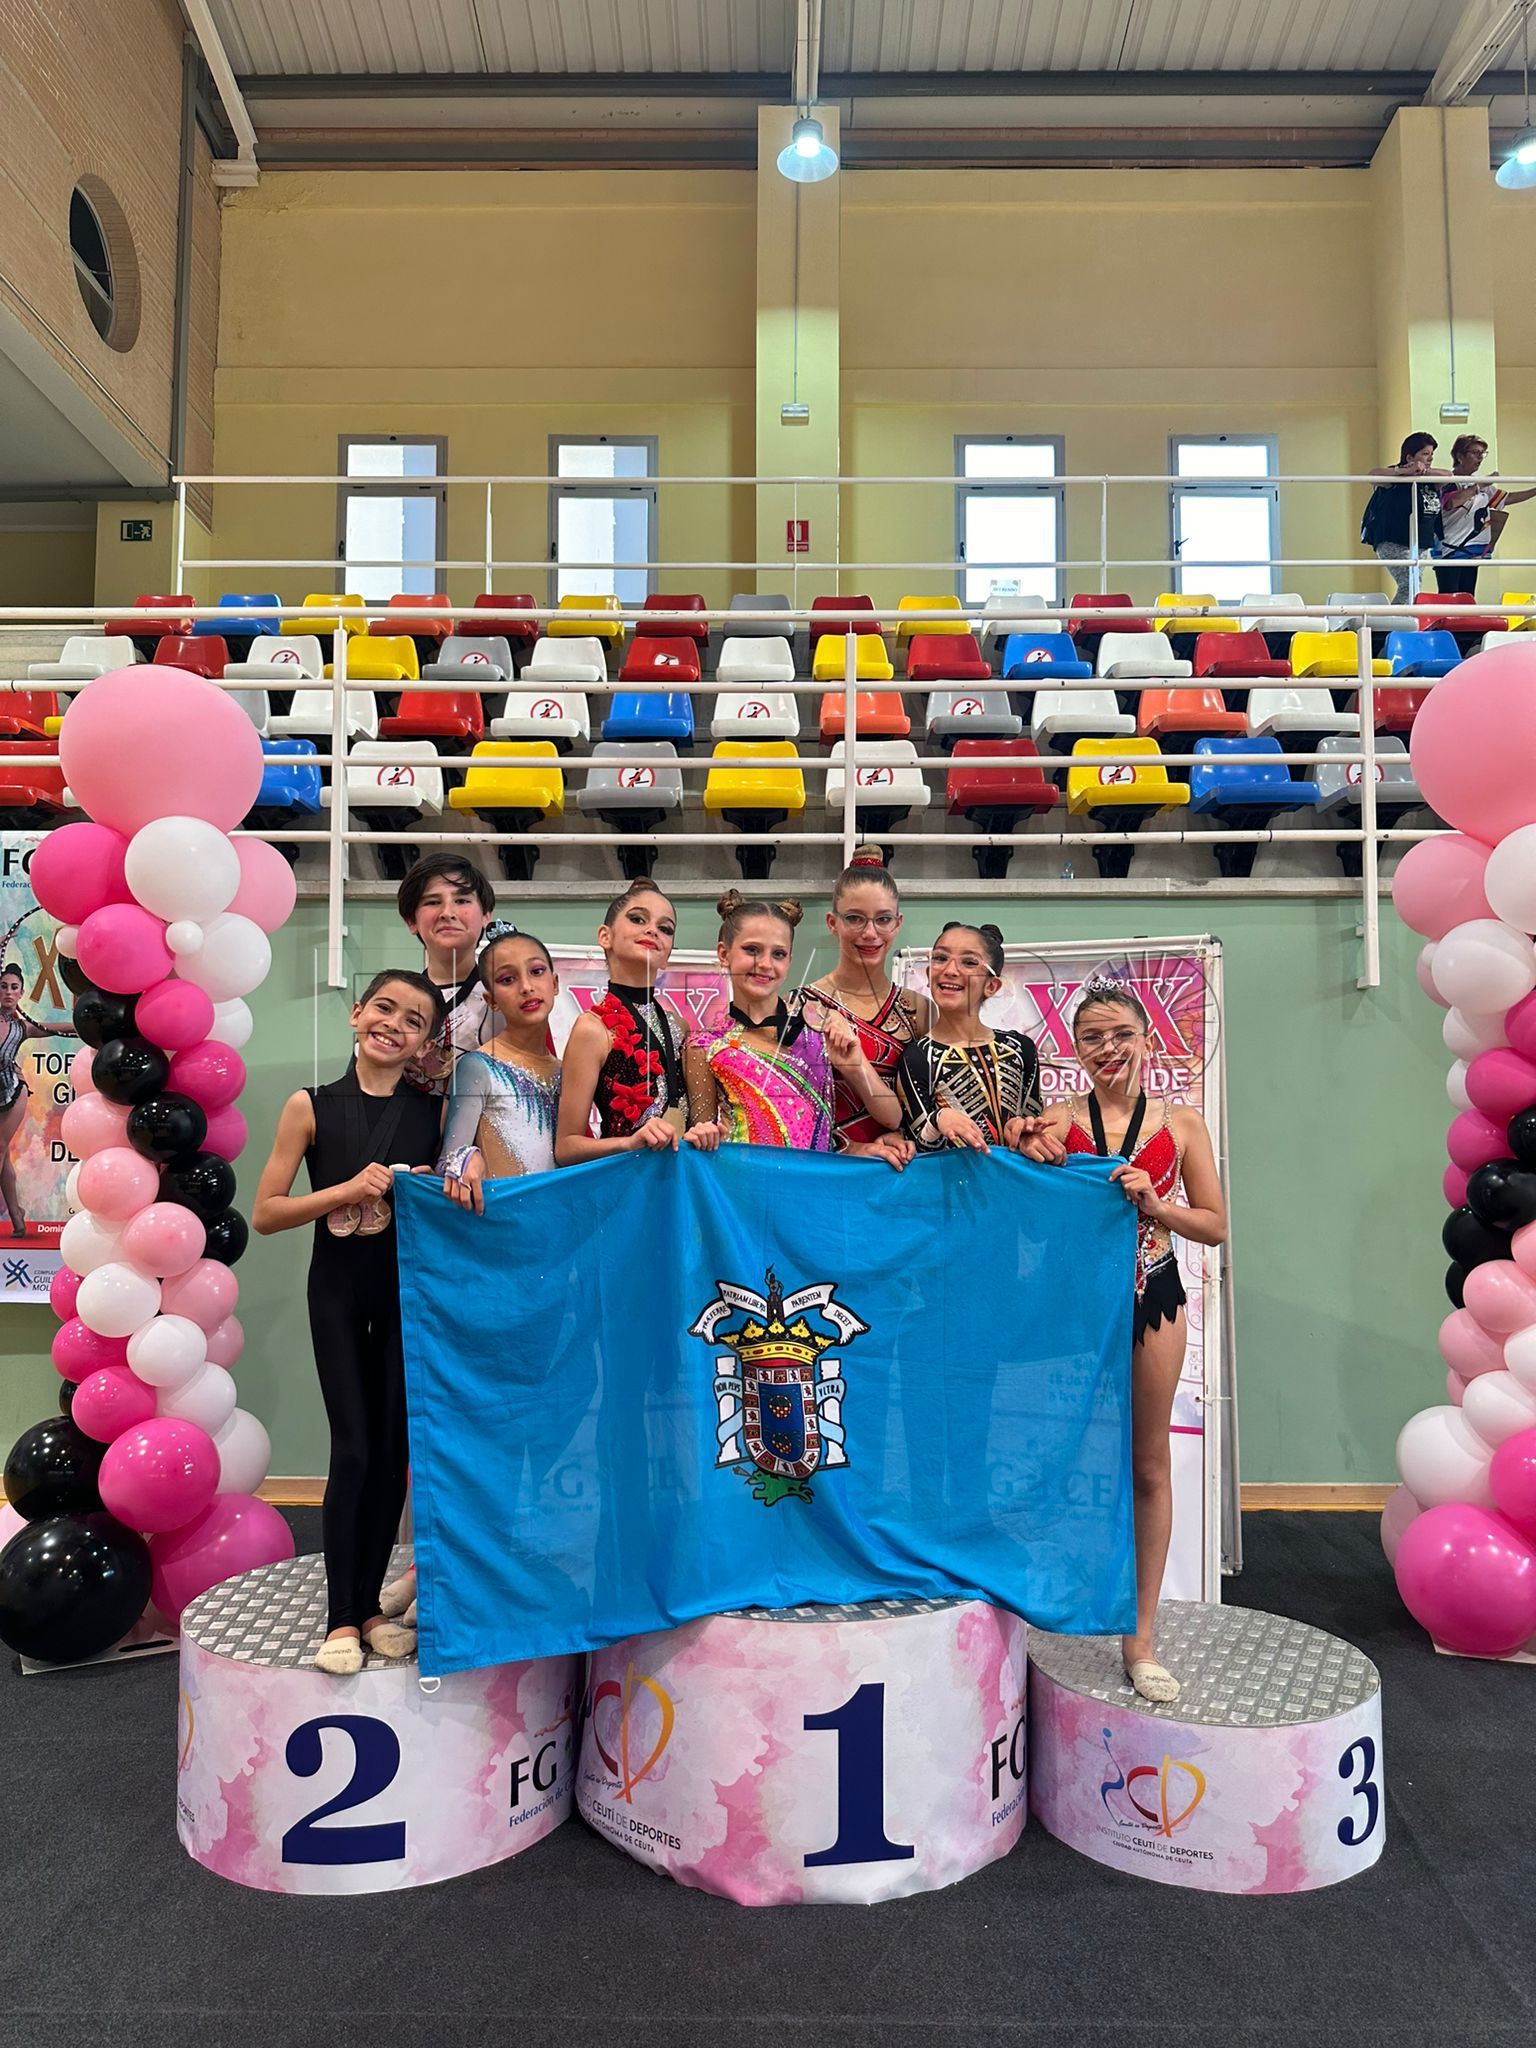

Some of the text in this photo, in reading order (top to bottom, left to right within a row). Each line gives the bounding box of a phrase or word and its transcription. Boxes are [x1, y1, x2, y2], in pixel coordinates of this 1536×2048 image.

[1150, 1068, 1190, 1092] DE
[790, 1290, 822, 1308] PARENTEM
[282, 1714, 406, 1865] 2
[510, 1740, 557, 1808] FG
[803, 1682, 915, 1868] 1
[1337, 1735, 1379, 1847] 3
[592, 1800, 615, 1822] CEUTÍ
[616, 1812, 628, 1828] DE
[629, 1819, 681, 1850] DEPORTES
[634, 1838, 655, 1853] CEUTA
[1095, 1825, 1214, 1860] INSTITUTO CEUTÍ DE DEPORTES
[1174, 1856, 1193, 1864] CEUTA
